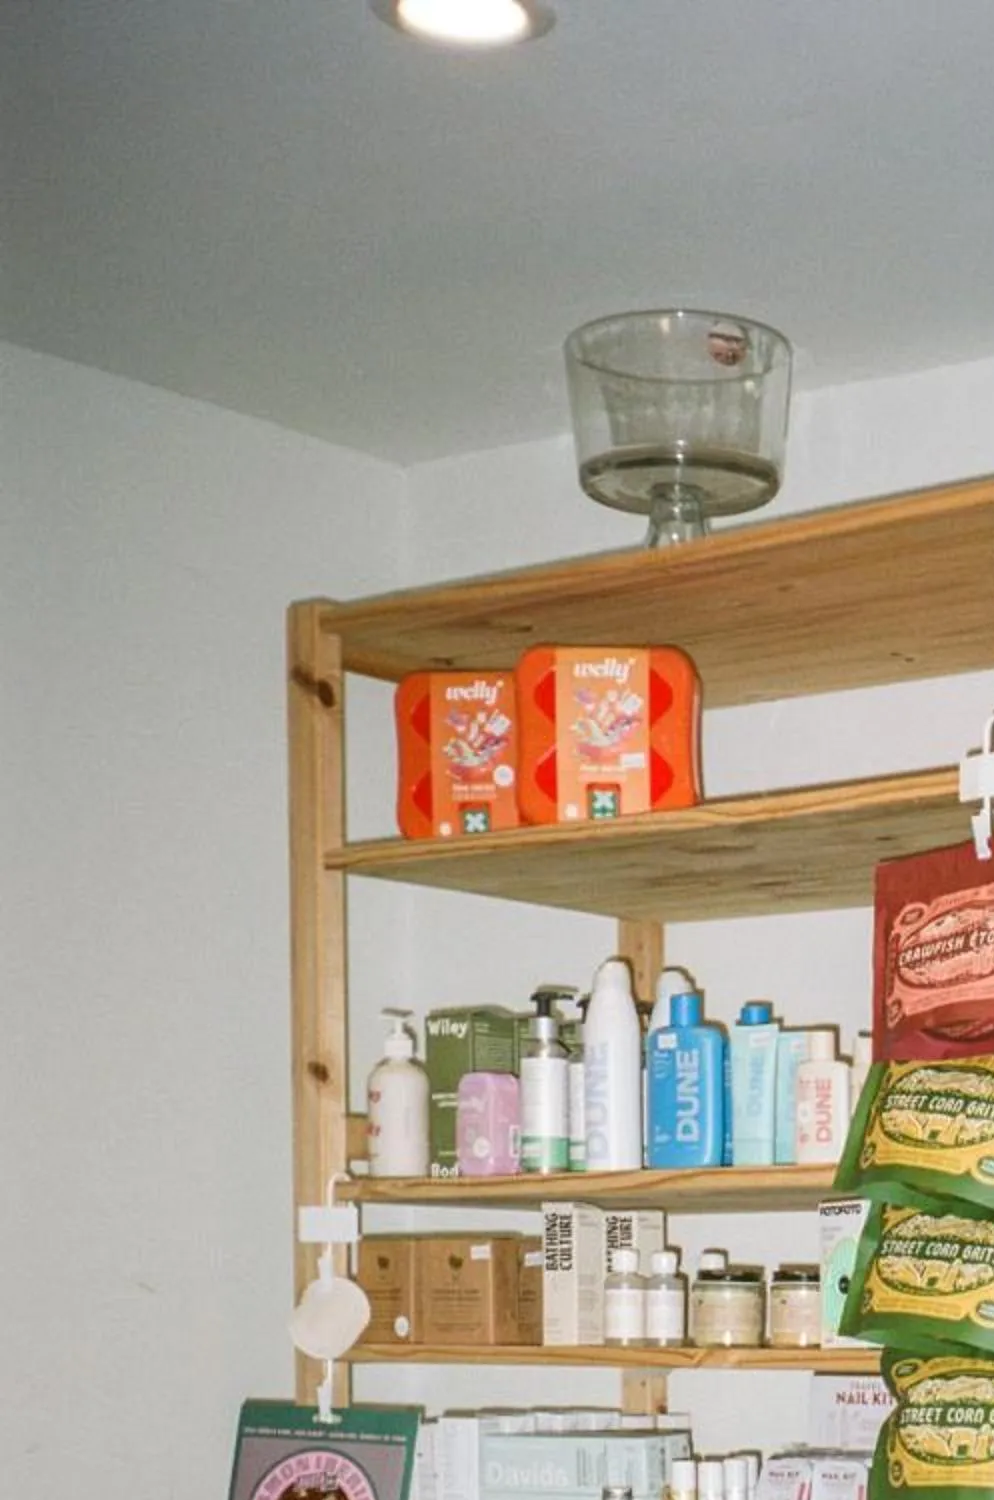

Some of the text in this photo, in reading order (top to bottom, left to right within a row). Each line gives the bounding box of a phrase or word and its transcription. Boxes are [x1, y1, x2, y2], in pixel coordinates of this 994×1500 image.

[573, 657, 630, 683] welly
[446, 682, 498, 705] welly
[427, 1020, 468, 1038] Wiley
[676, 1048, 700, 1143] DUNE
[886, 1094, 927, 1111] STREET
[929, 1096, 964, 1114] CORN
[815, 1077, 832, 1143] DUNE
[545, 1211, 558, 1272] BATHING
[559, 1212, 573, 1271] CULTURE
[881, 1240, 924, 1256] STREET
[926, 1242, 960, 1258] CORN
[835, 1391, 868, 1404] NAIL
[901, 1406, 941, 1424] STREET
[946, 1406, 985, 1422] CORN
[487, 1462, 568, 1487] Davids
